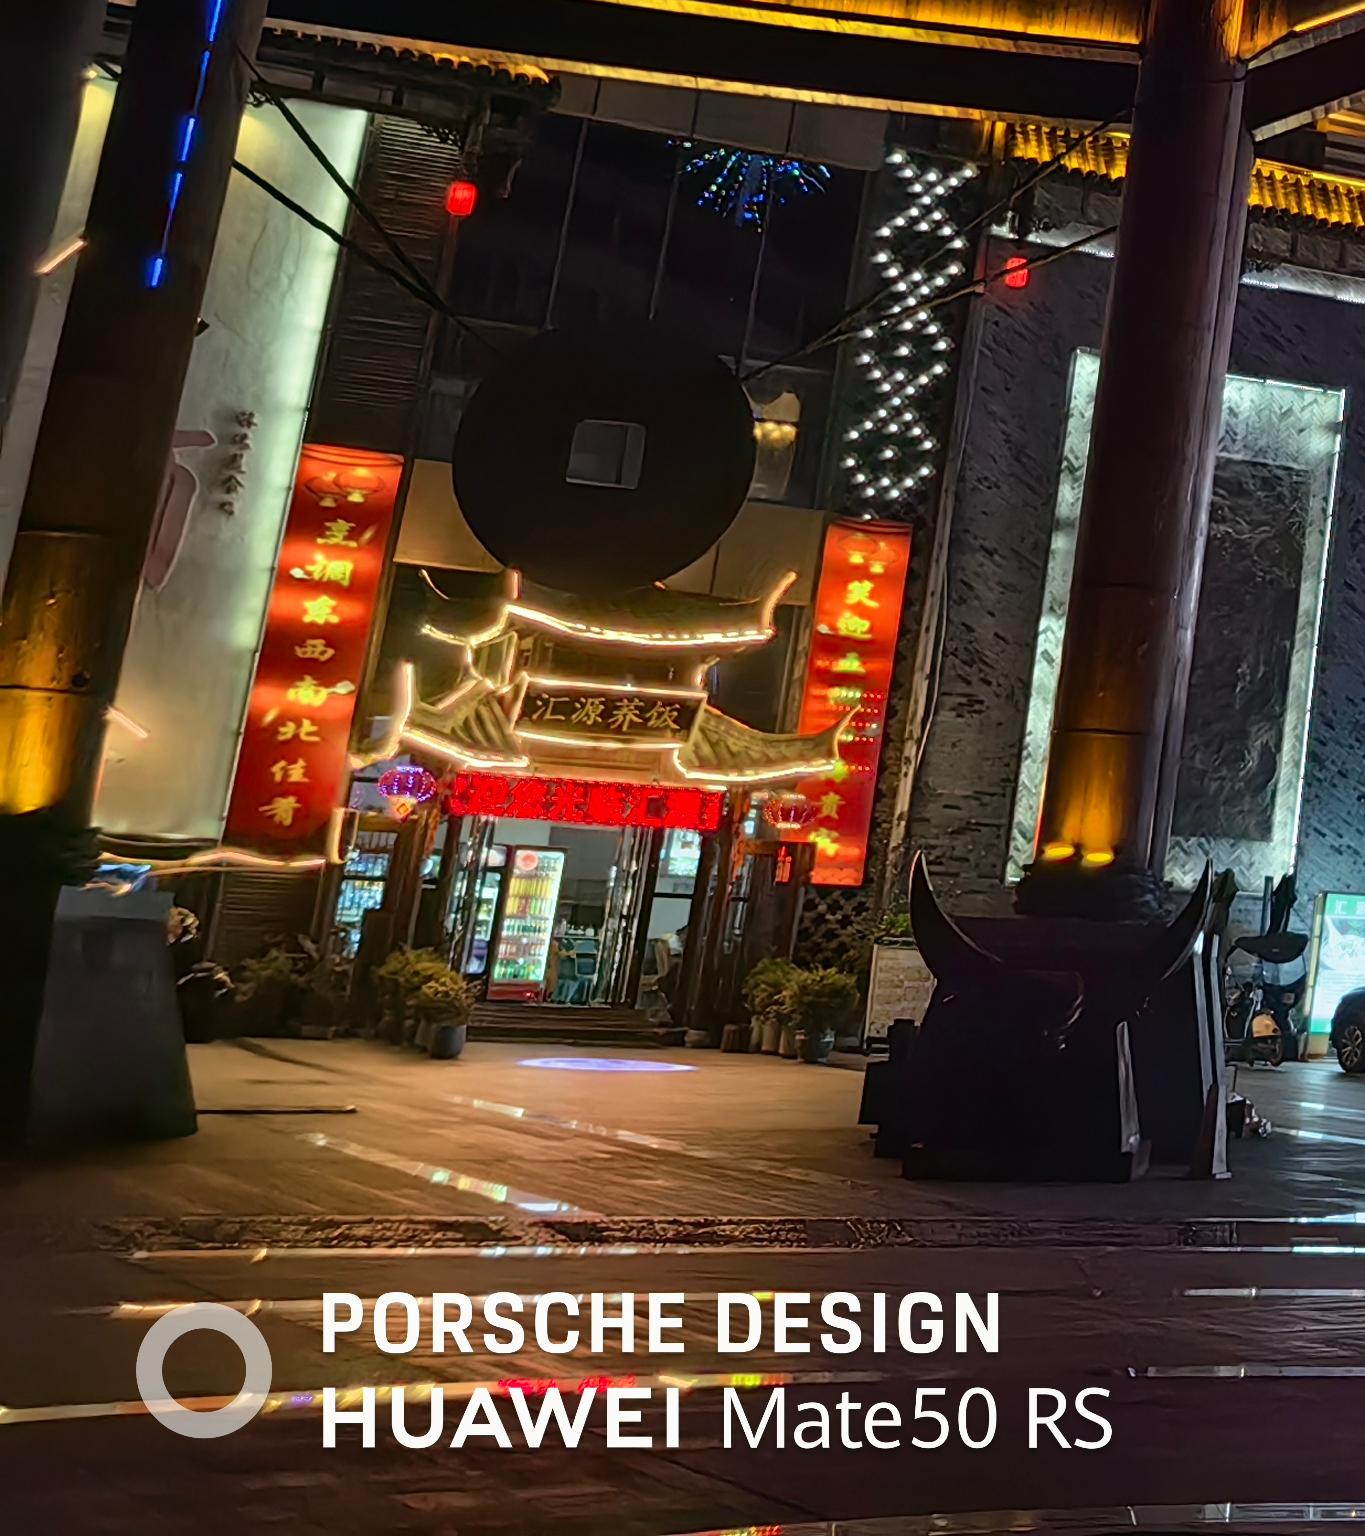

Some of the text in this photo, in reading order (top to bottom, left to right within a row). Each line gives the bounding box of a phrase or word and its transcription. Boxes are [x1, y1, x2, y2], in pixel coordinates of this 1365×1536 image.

[258, 519, 359, 827] 烹调东西南北佳肴
